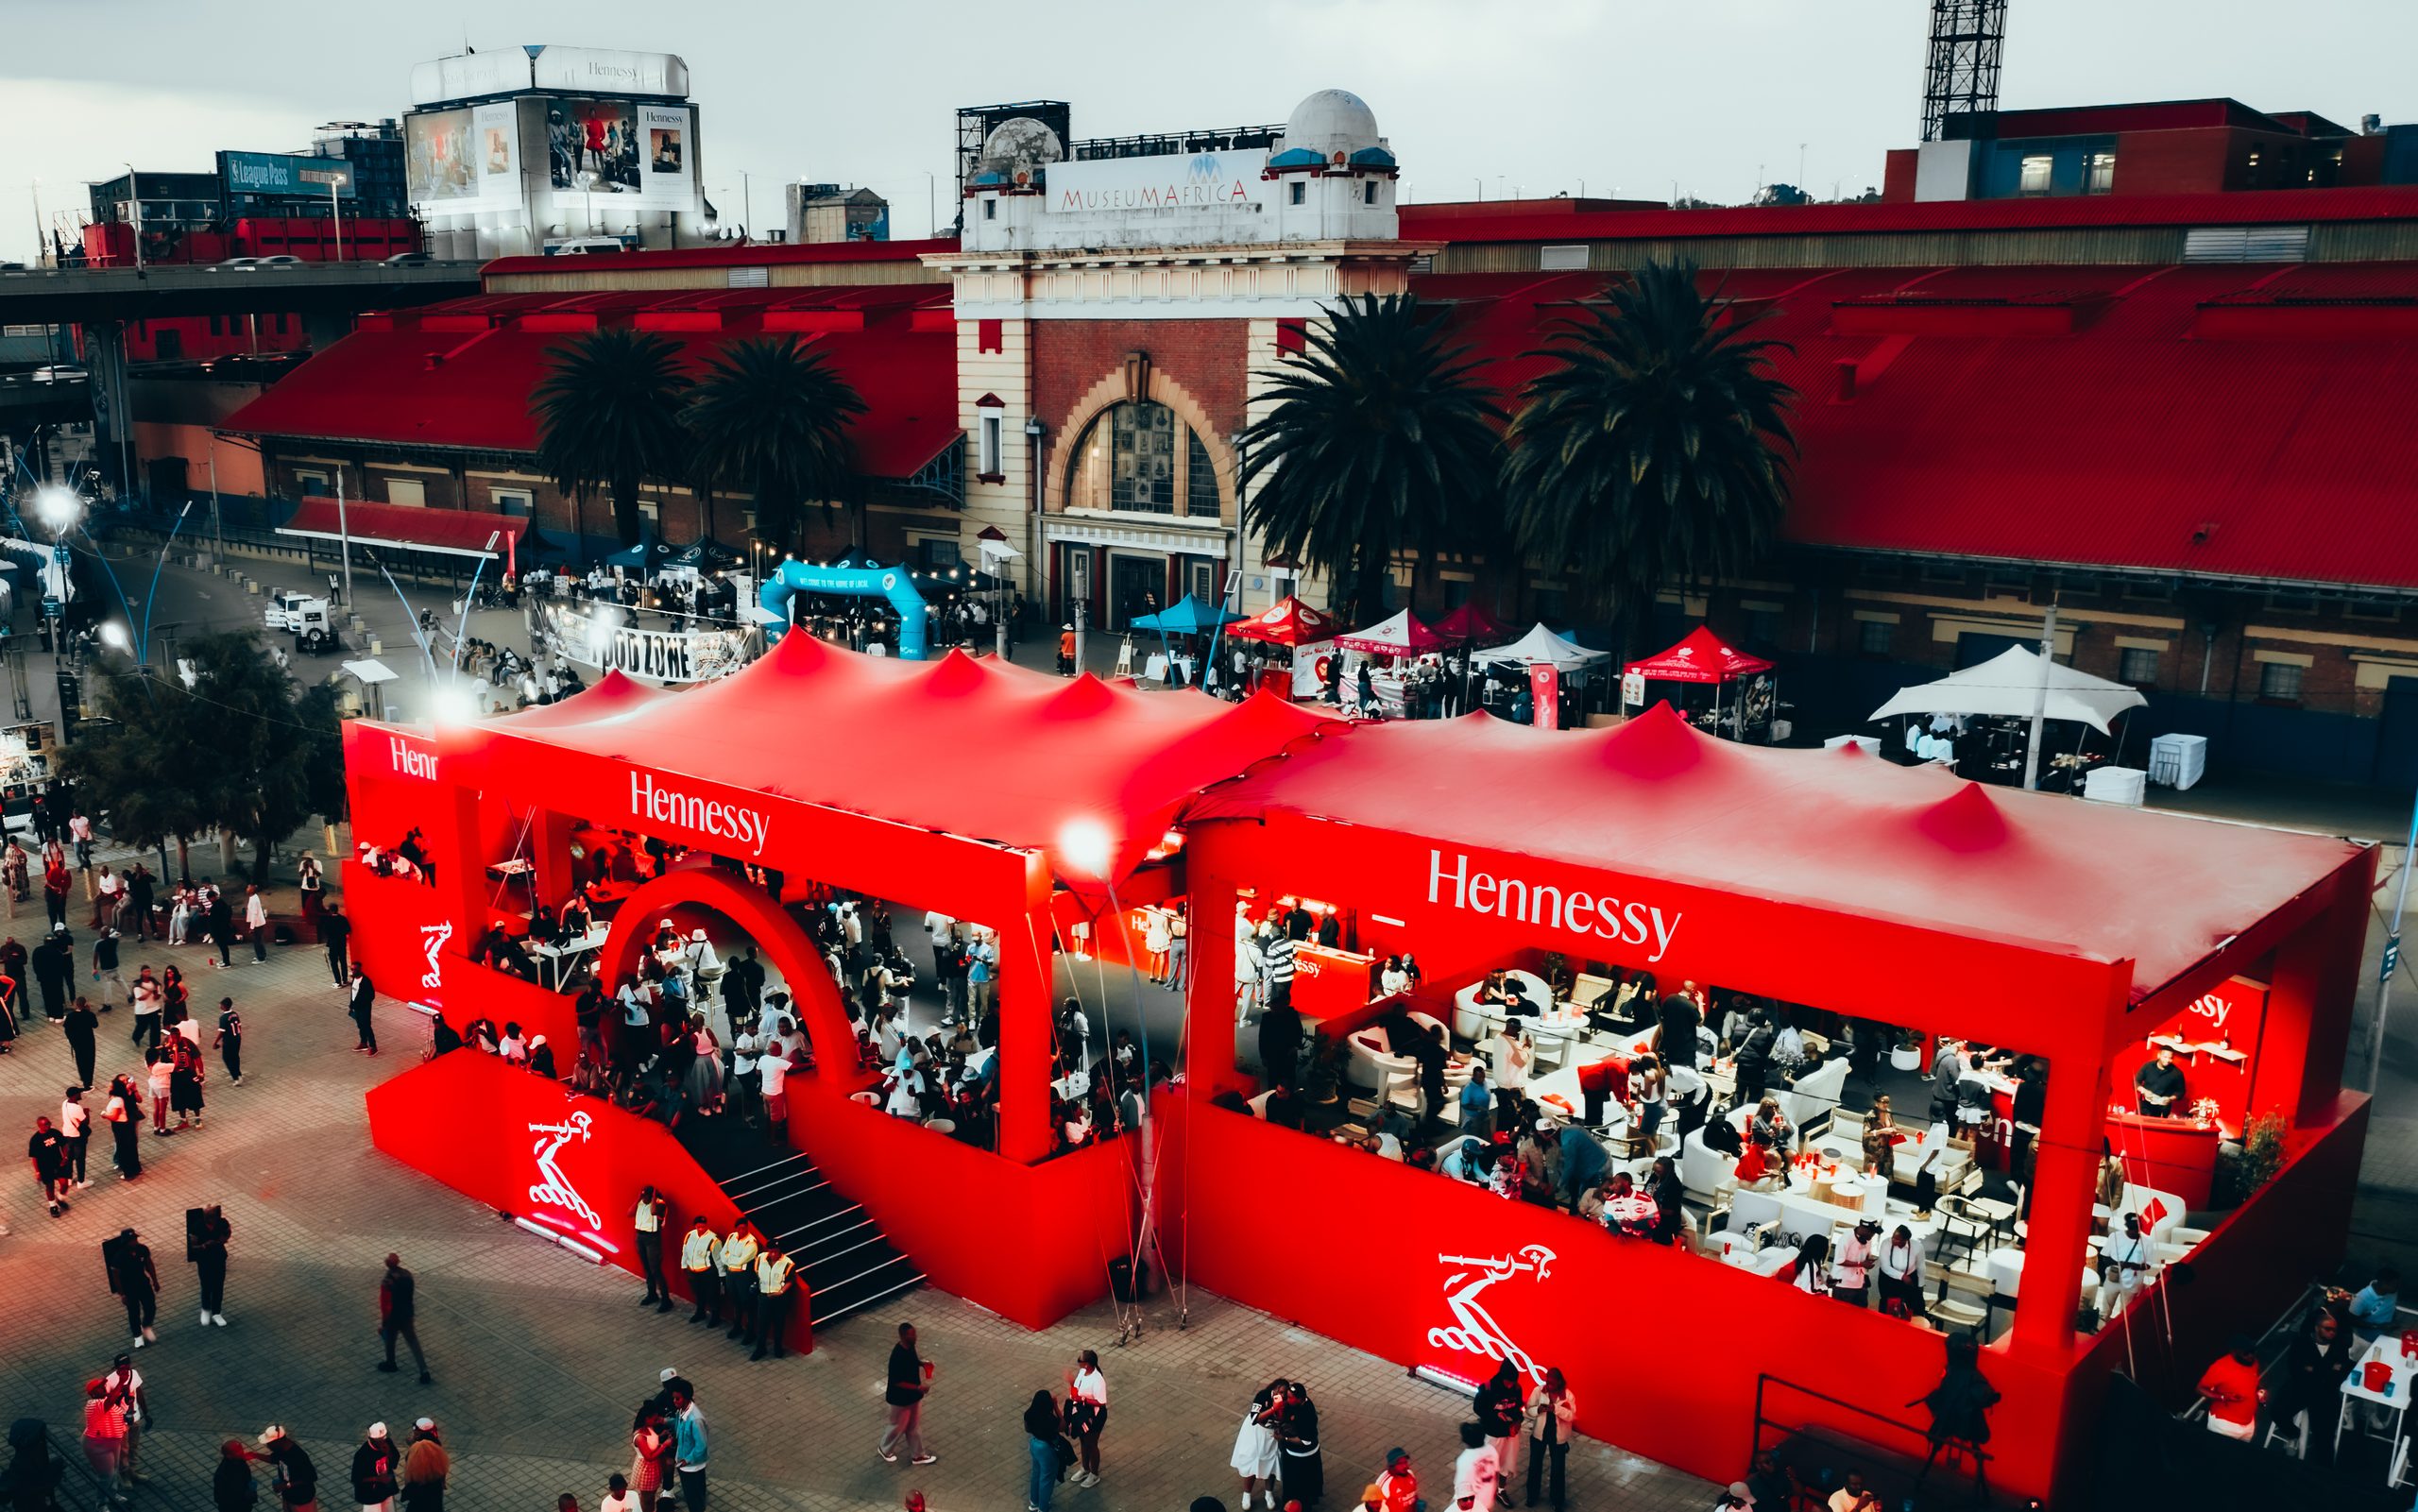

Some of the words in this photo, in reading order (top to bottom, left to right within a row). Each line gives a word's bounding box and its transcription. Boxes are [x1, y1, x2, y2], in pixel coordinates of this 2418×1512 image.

[588, 61, 638, 81] Hennessy
[646, 111, 683, 126] Hennessy
[239, 161, 269, 188] League
[269, 162, 288, 186] Pass
[855, 579, 869, 588] LOCAL
[592, 629, 639, 672] OOD
[644, 635, 691, 679] ZONE
[630, 771, 770, 857] Hennessy
[1428, 849, 1682, 962] Hennessy
[1294, 959, 1321, 977] essy
